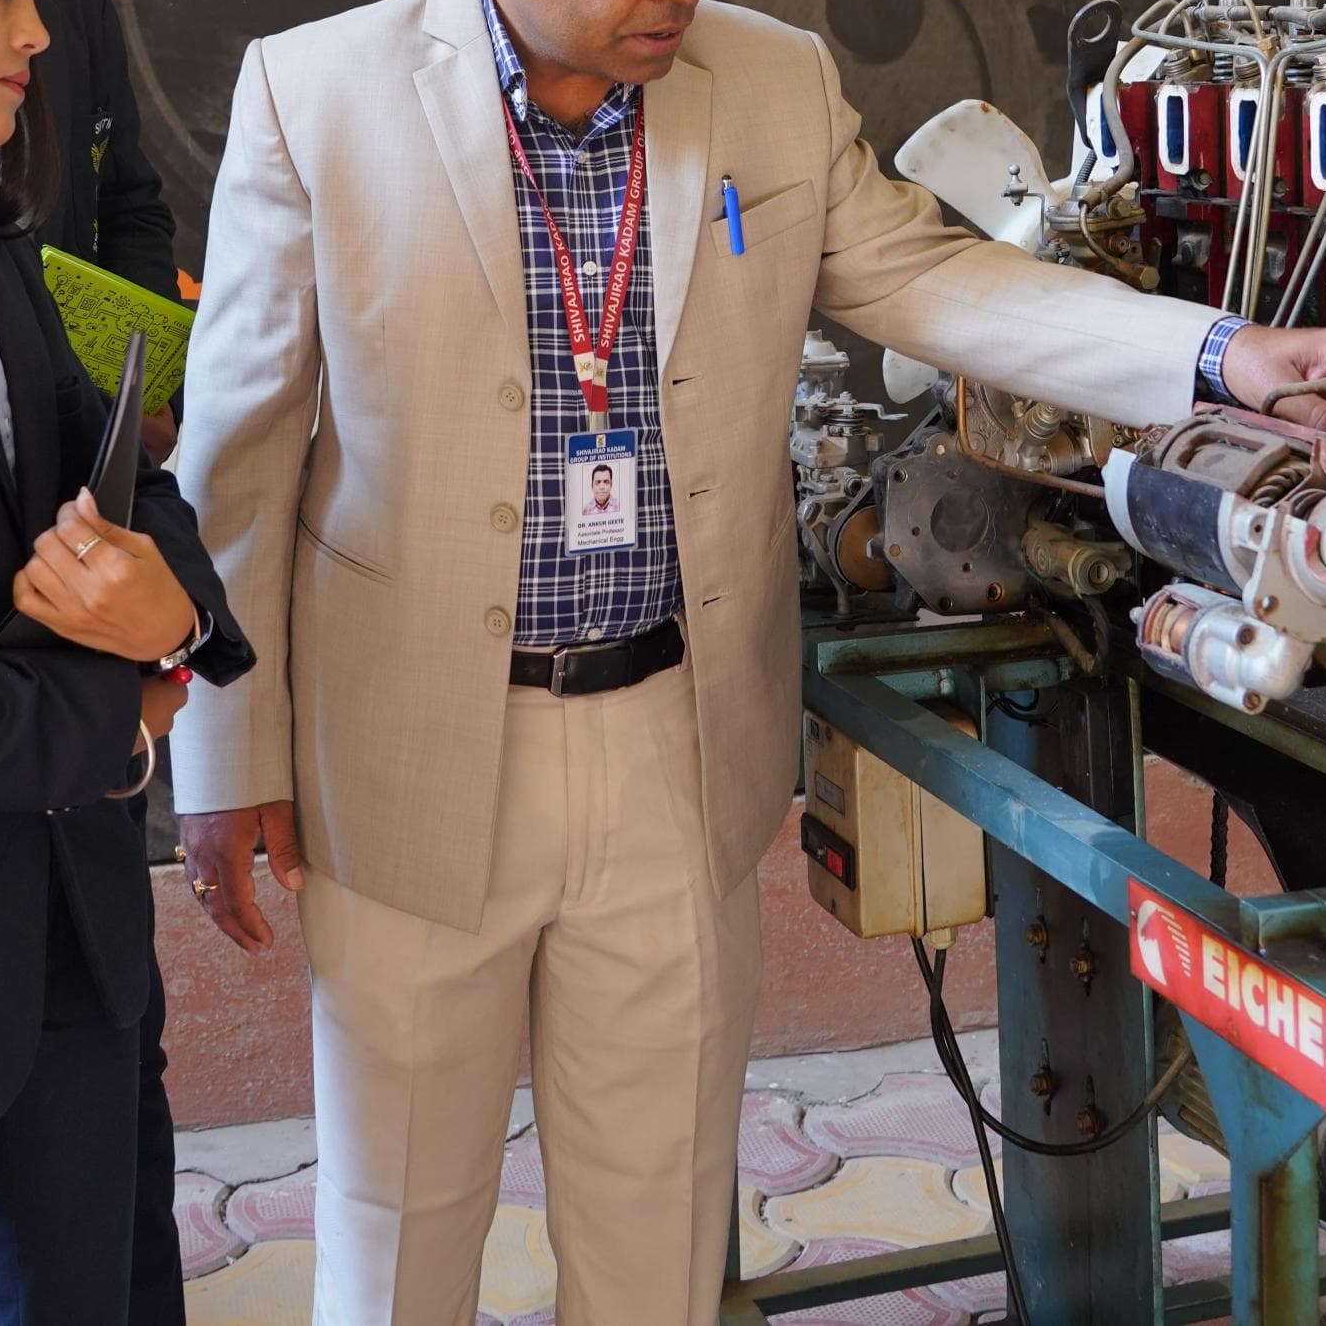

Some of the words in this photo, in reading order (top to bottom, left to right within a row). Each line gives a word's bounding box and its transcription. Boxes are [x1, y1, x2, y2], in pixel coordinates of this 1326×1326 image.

[559, 254, 586, 343] SHIVAJIRAO
[600, 260, 628, 348] SHIVAJIRAO
[618, 203, 638, 259] KADAM
[629, 148, 646, 200] GROUP
